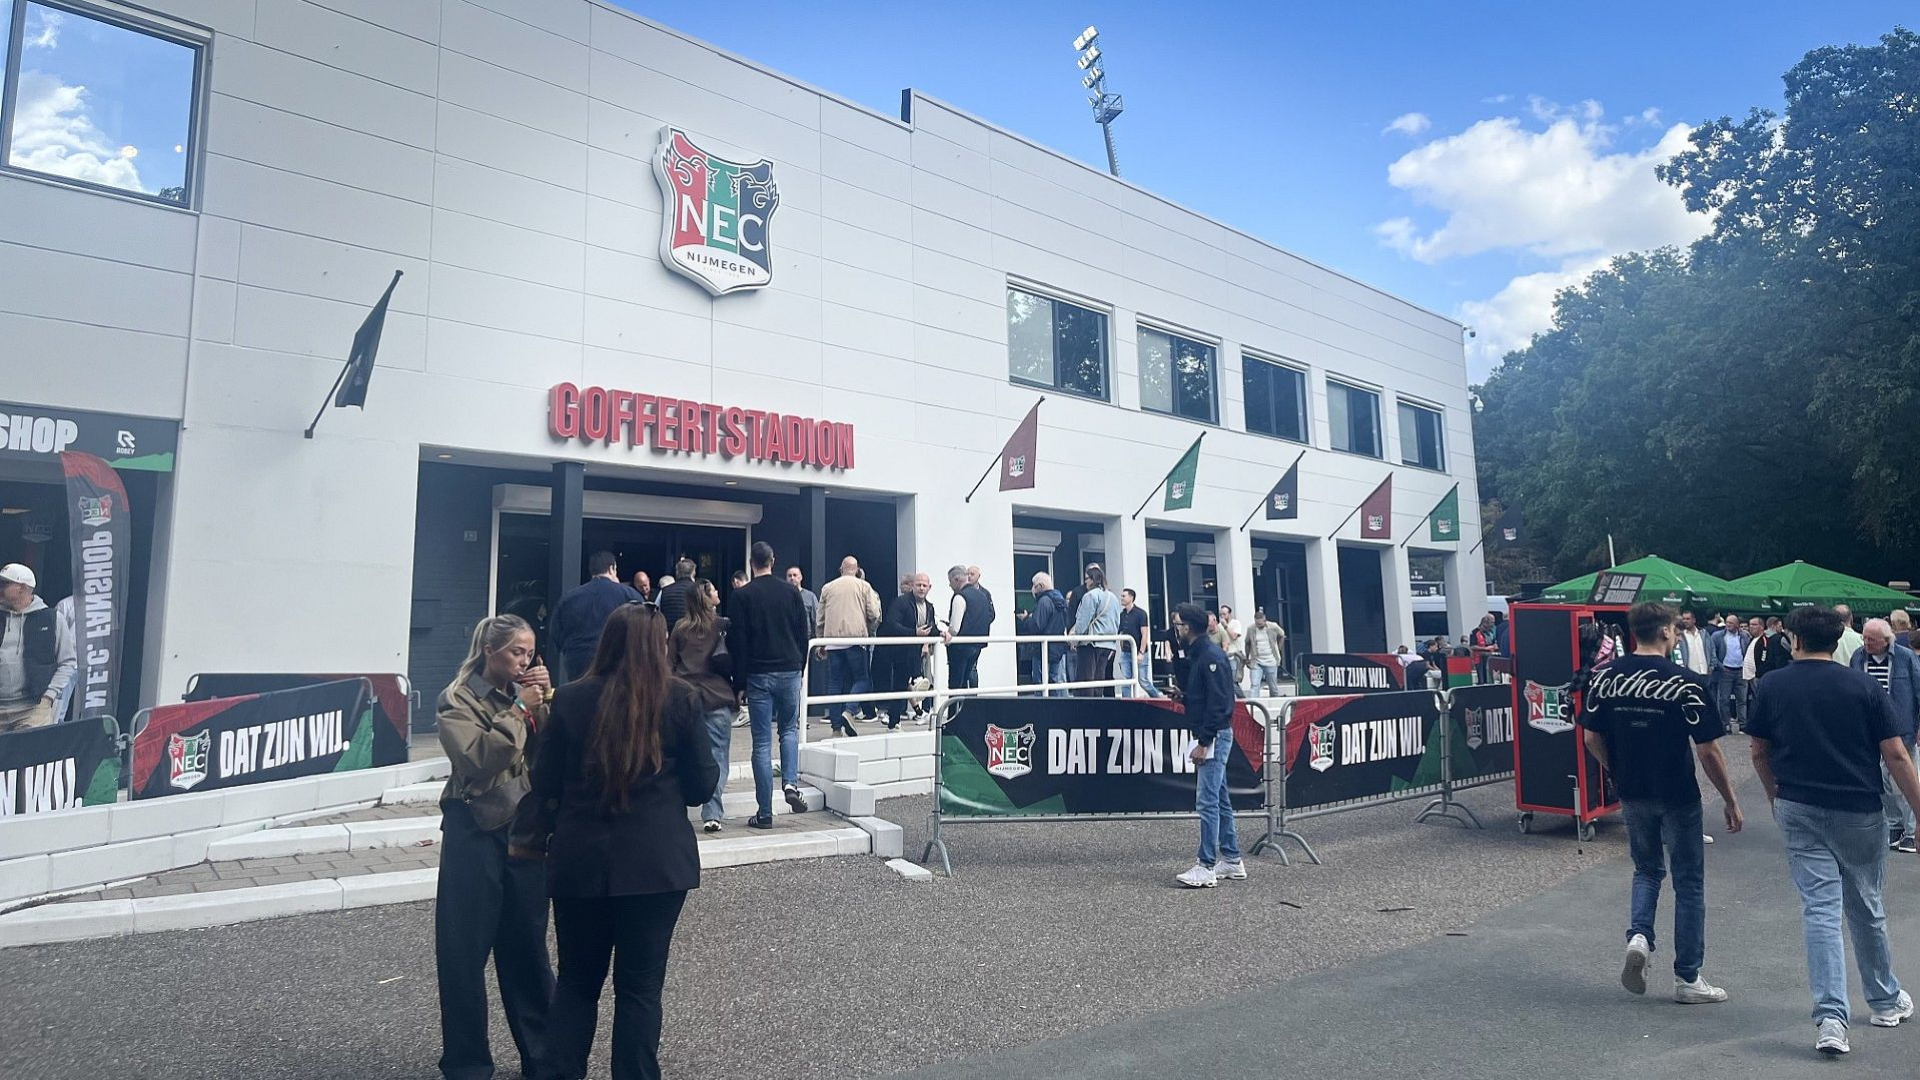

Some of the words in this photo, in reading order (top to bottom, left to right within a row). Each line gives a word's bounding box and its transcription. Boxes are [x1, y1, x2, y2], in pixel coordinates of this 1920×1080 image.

[681, 194, 764, 251] NEC
[687, 251, 756, 276] NIJMEGEN
[548, 382, 855, 469] GOFFERTSTADION
[1328, 666, 1345, 687] DAT
[1346, 667, 1367, 688] ZIJN
[1485, 707, 1504, 744] DAT
[1532, 702, 1569, 718] NEC
[219, 725, 262, 779] DAT
[262, 716, 305, 770] ZIJN
[309, 710, 350, 758] WIJ.
[992, 747, 1028, 761] NEC
[1047, 728, 1100, 775] DAT
[1106, 728, 1163, 775] ZIJN
[1312, 743, 1333, 757] NEC
[1341, 722, 1367, 765] DAT
[1369, 718, 1397, 761] ZIJN
[1399, 716, 1426, 757] WIJ.
[174, 753, 206, 773] NEC
